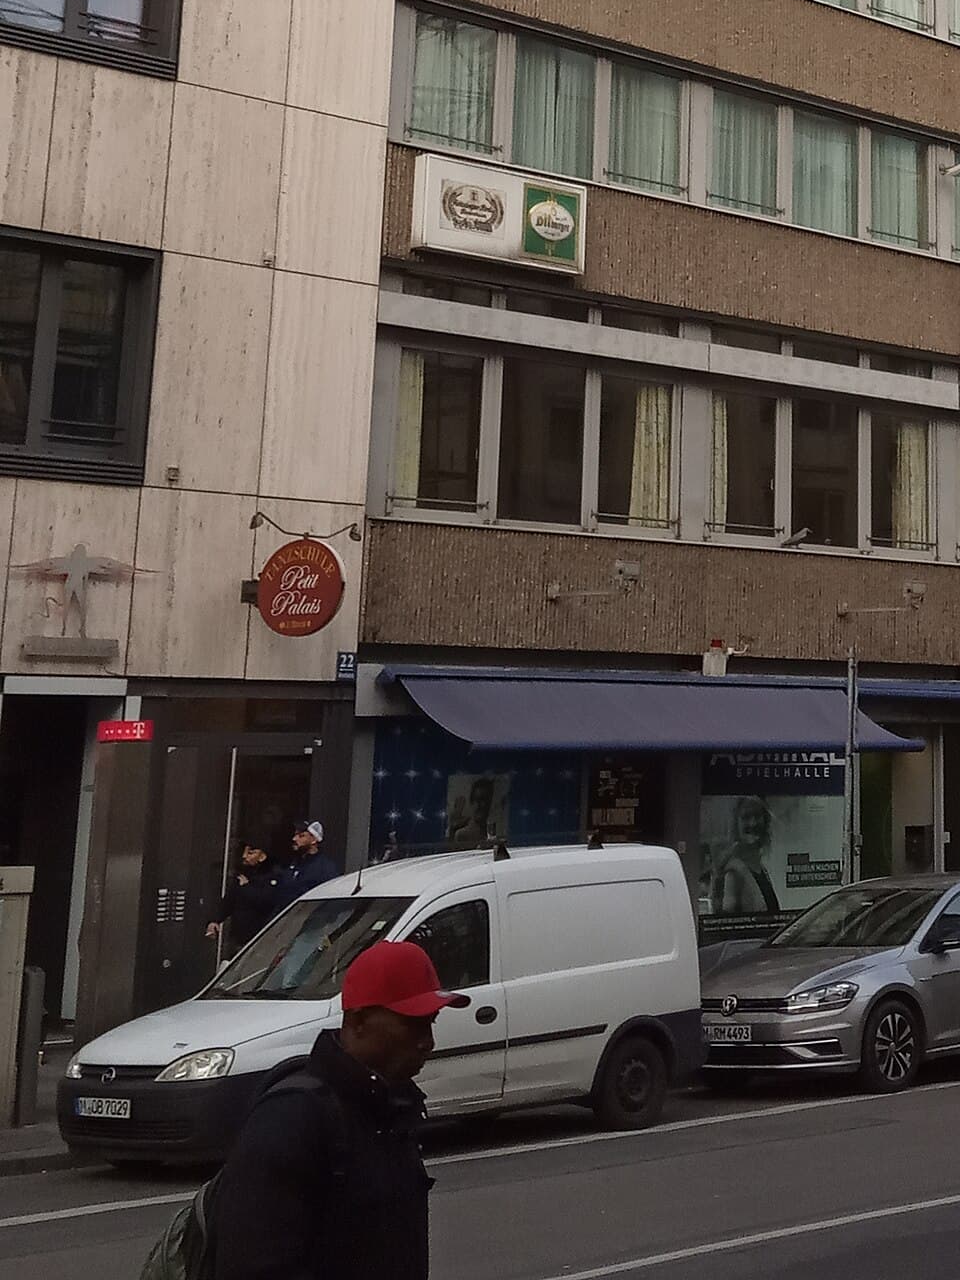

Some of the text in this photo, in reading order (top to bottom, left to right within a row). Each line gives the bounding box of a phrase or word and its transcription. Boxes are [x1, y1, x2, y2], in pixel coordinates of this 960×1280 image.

[280, 565, 319, 591] Petit
[270, 591, 321, 616] Palais
[340, 654, 354, 668] 22
[736, 767, 830, 778] SPIELHALLE
[727, 1027, 750, 1040] 4493
